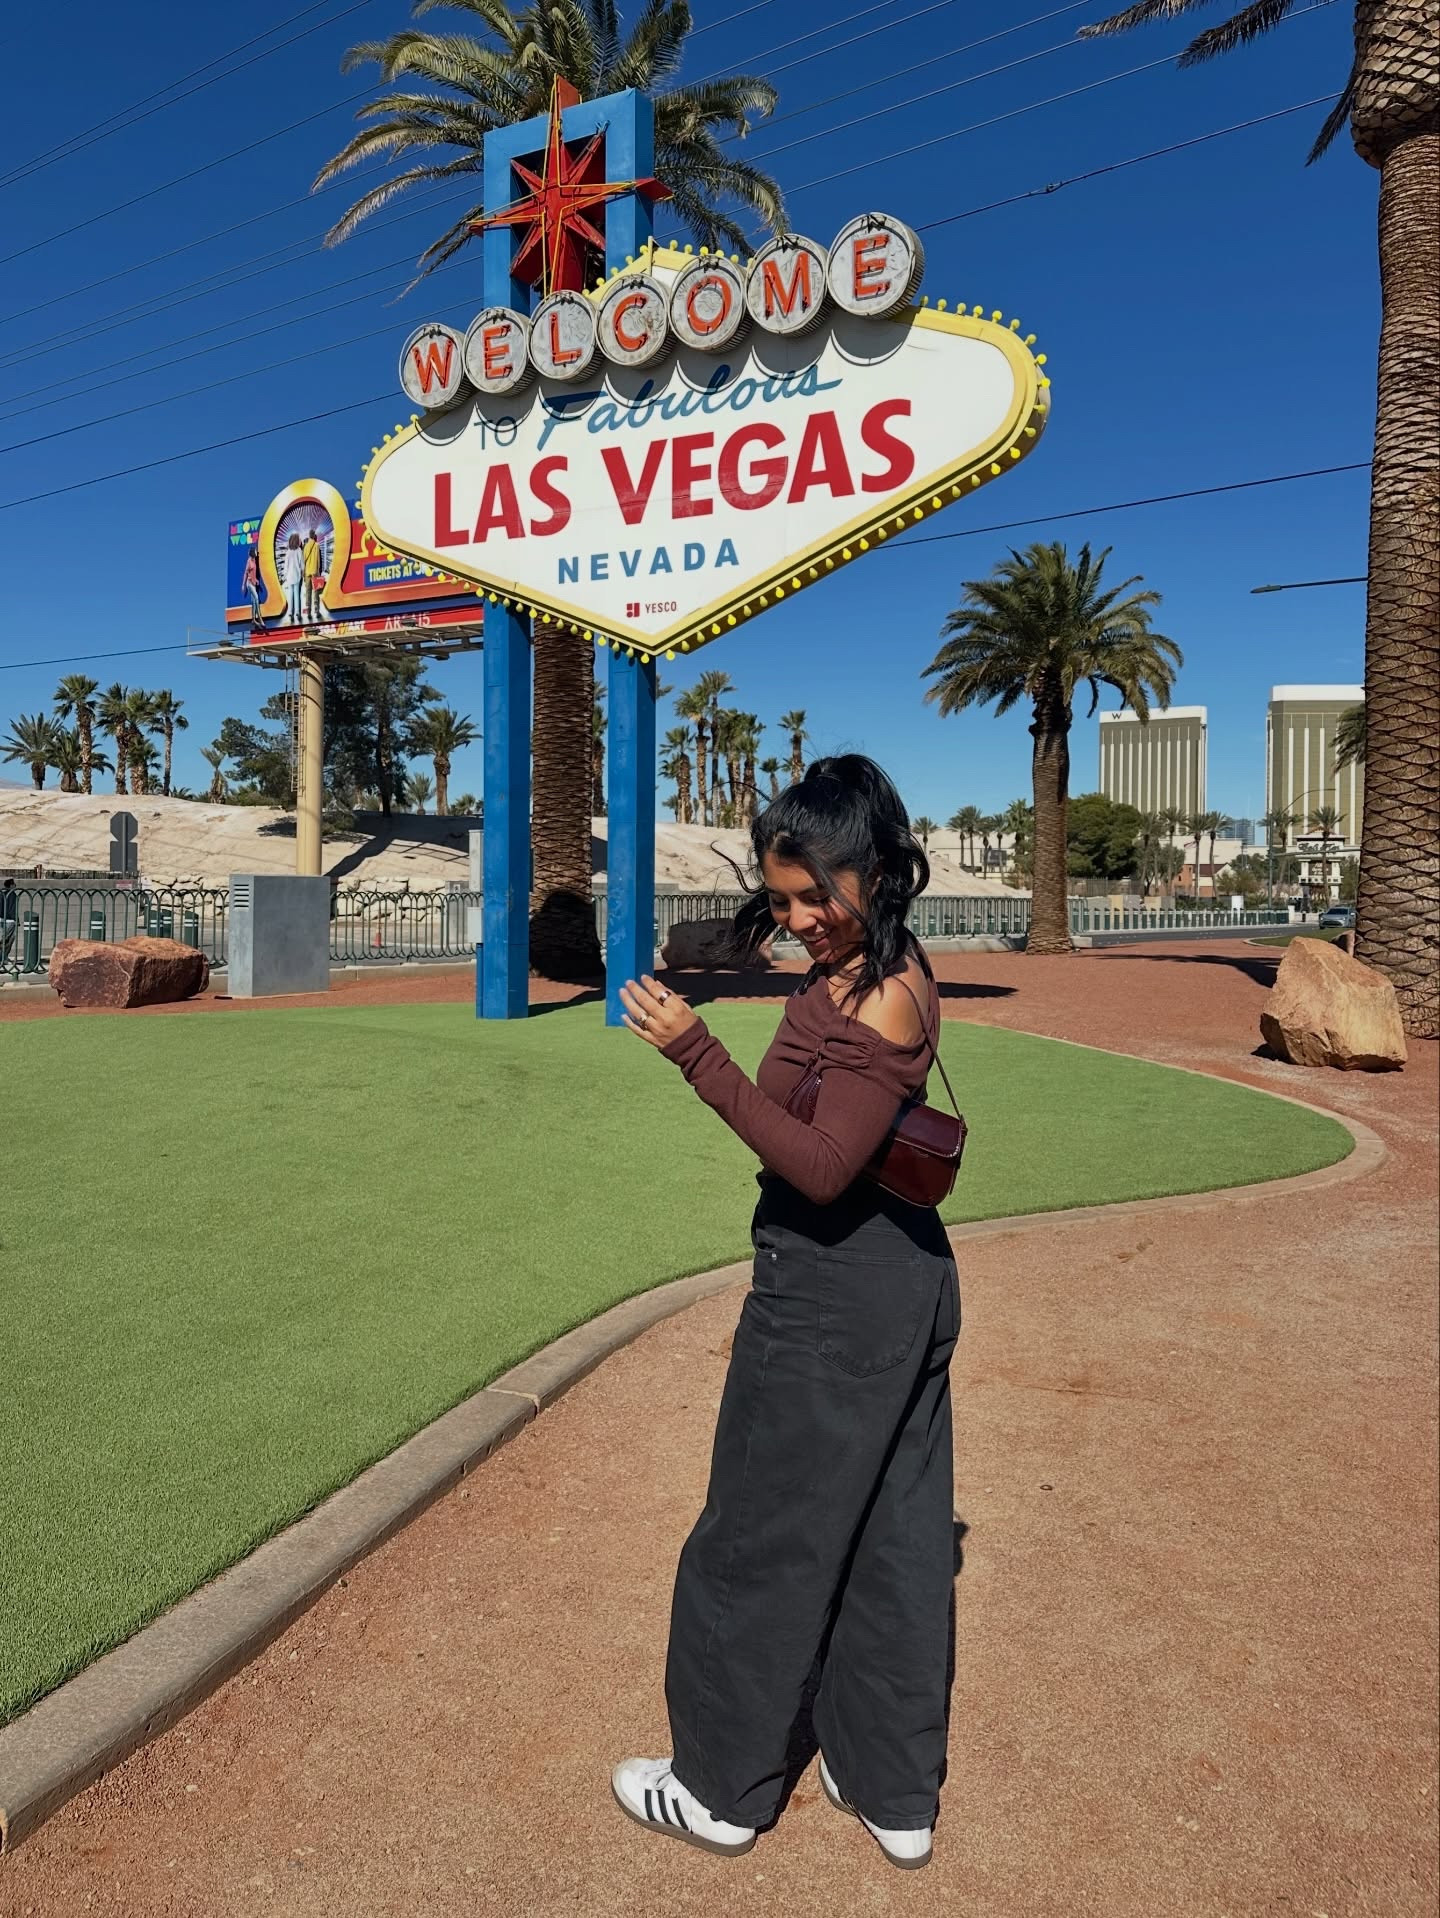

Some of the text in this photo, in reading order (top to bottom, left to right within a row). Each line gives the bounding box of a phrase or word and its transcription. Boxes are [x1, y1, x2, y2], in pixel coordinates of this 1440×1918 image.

[411, 233, 890, 394] WELCOME
[474, 363, 843, 451] TO Fabulous
[434, 399, 917, 549] LAS VEGAS
[230, 520, 261, 535] MEOW
[368, 565, 401, 583] TICKETS
[558, 538, 739, 585] NEVADA
[645, 601, 677, 614] YESCO
